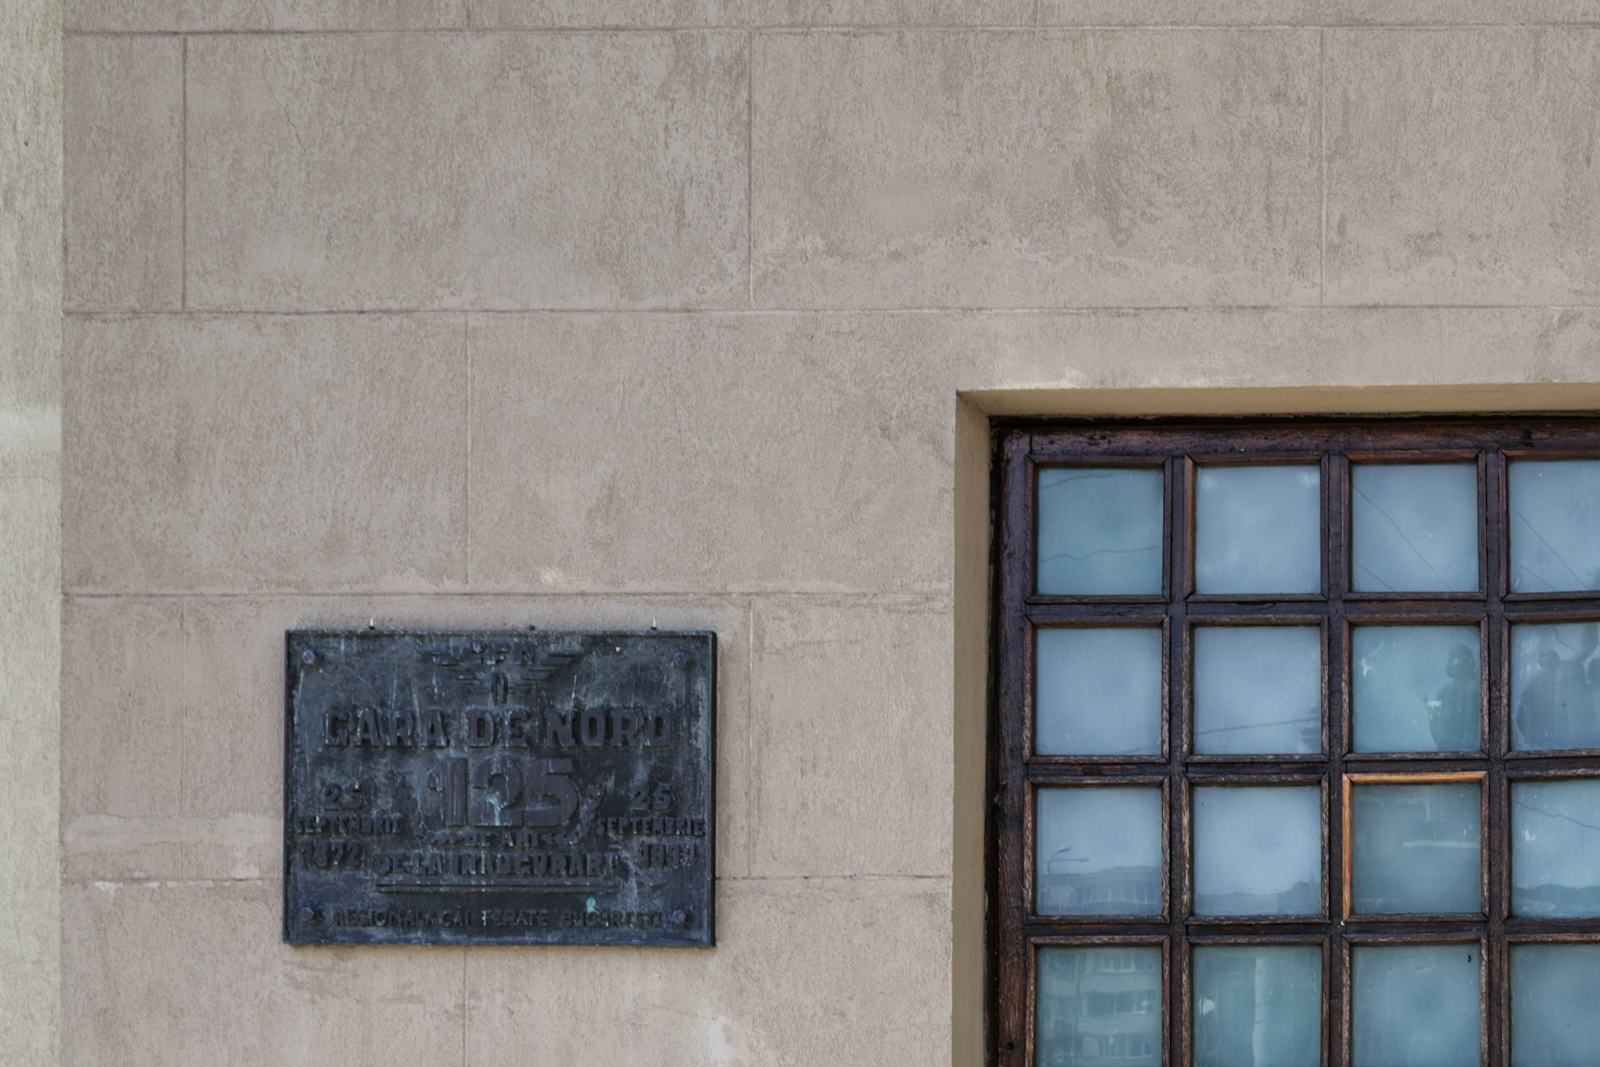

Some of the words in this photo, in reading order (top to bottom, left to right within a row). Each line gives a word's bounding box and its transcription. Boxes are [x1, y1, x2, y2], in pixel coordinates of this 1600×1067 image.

[324, 707, 450, 748] GARA
[467, 707, 530, 748] DE
[543, 708, 674, 749] NORD
[324, 783, 364, 811] 25
[428, 757, 580, 828] 125
[631, 784, 674, 812] 25
[294, 814, 404, 834] SEPTEMBRIE
[596, 816, 706, 837] SEPTEMBRIE
[464, 832, 491, 847] DE
[501, 831, 539, 847] ANI
[302, 839, 362, 868] 1872
[374, 852, 403, 876] DE
[414, 852, 445, 875] LA
[452, 851, 622, 877] INAUGURARE
